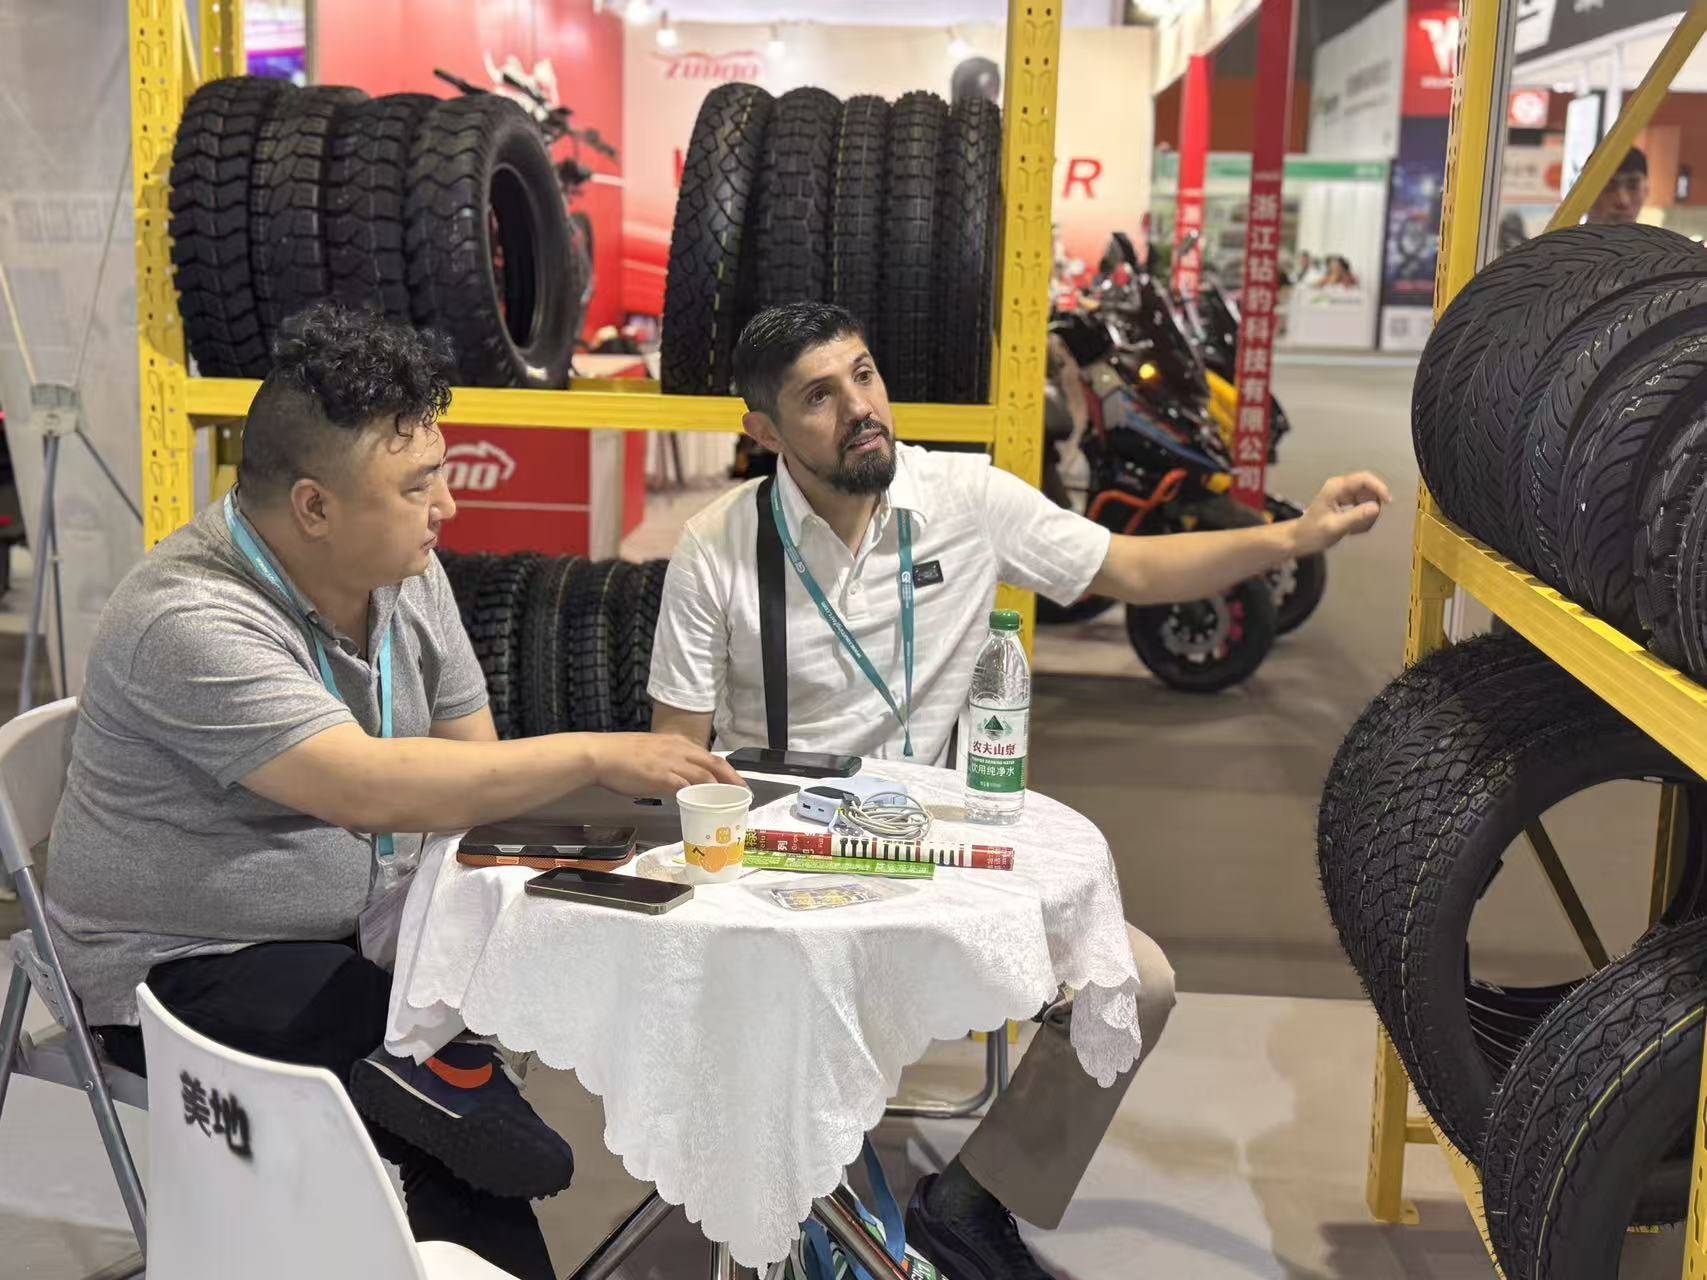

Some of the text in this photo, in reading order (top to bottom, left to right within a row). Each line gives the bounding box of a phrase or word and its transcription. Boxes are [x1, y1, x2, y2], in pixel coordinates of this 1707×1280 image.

[1238, 194, 1278, 492] 浙江钻豹科技有限公司
[973, 740, 1016, 756] 农夫山泉
[971, 762, 1015, 777] 饮用纯净水
